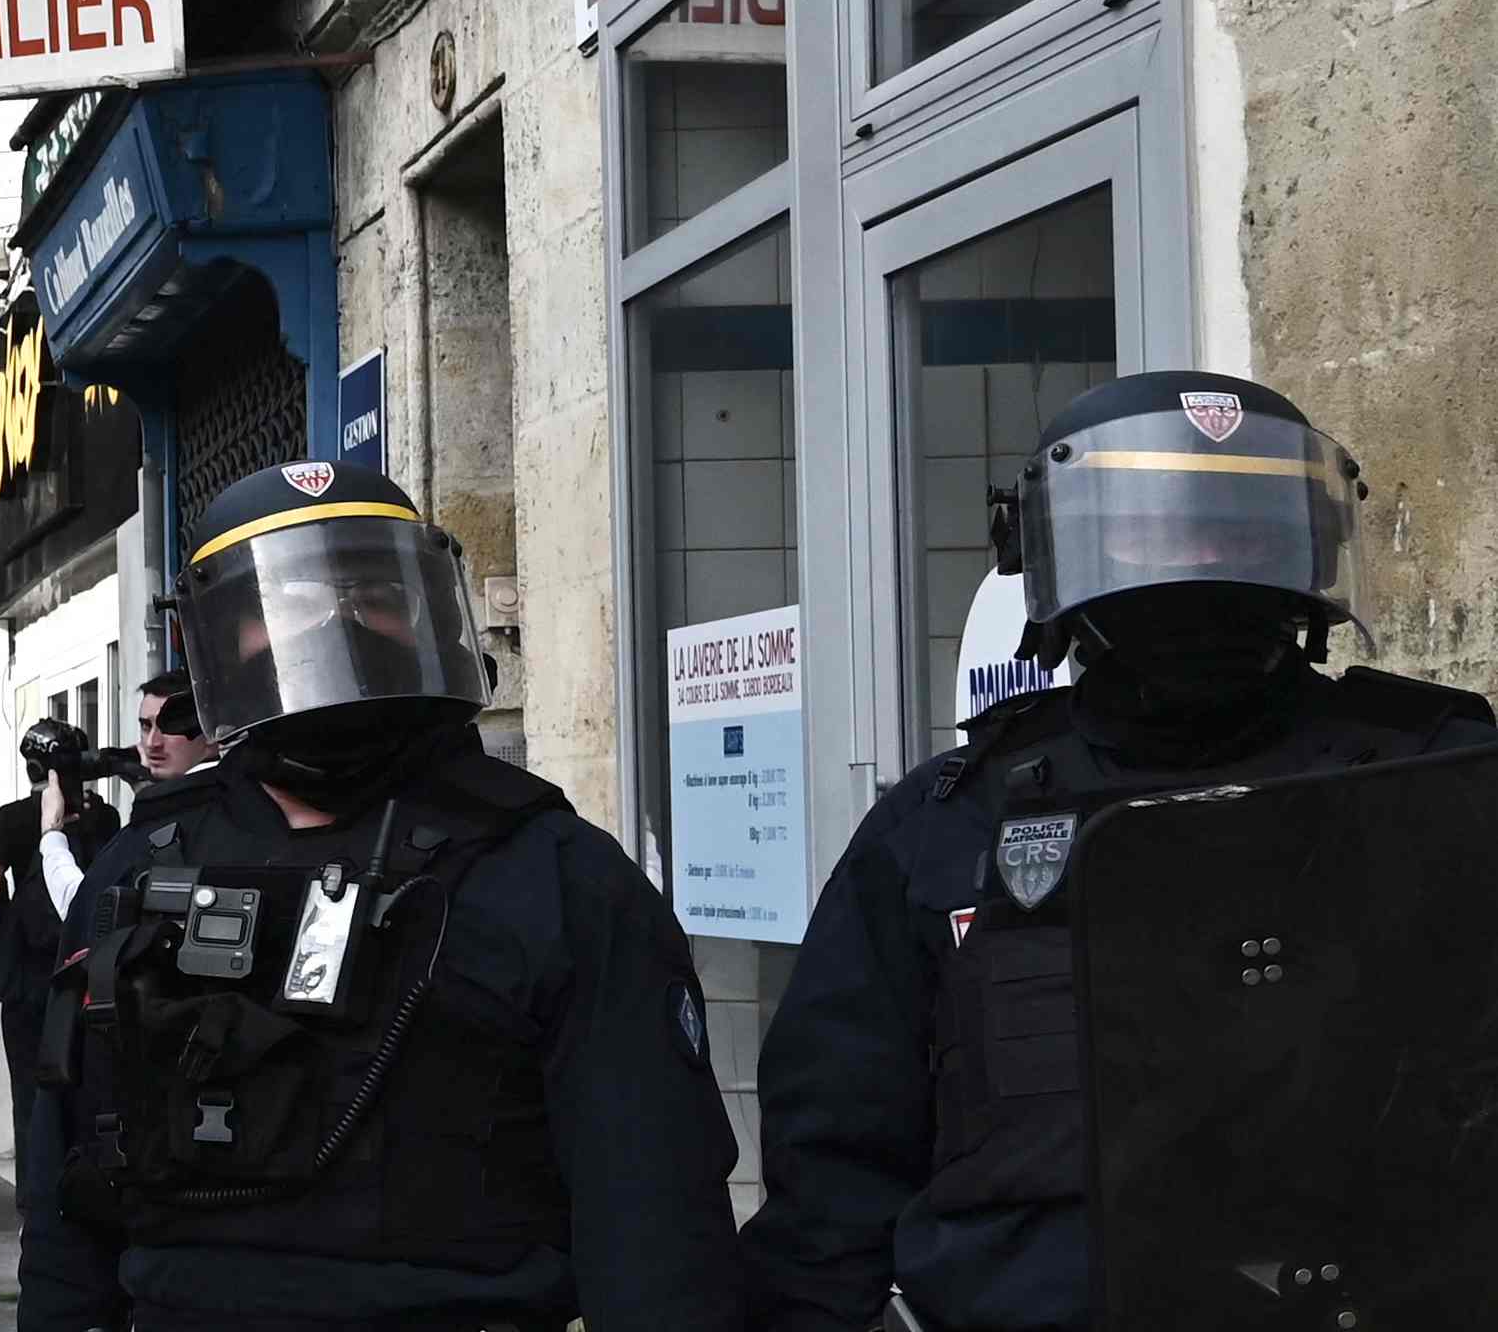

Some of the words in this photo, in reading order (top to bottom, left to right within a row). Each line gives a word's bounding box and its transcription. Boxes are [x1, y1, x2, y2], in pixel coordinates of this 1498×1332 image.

[343, 408, 379, 452] GESTION
[674, 647, 685, 681] LA
[688, 639, 724, 679] LAVERIE
[726, 637, 739, 674] DE
[742, 634, 754, 672] LA
[757, 627, 796, 669] SOMME
[1003, 829, 1070, 845] NATIONALE
[1011, 822, 1065, 836] POLICE
[1006, 842, 1062, 866] CRS
